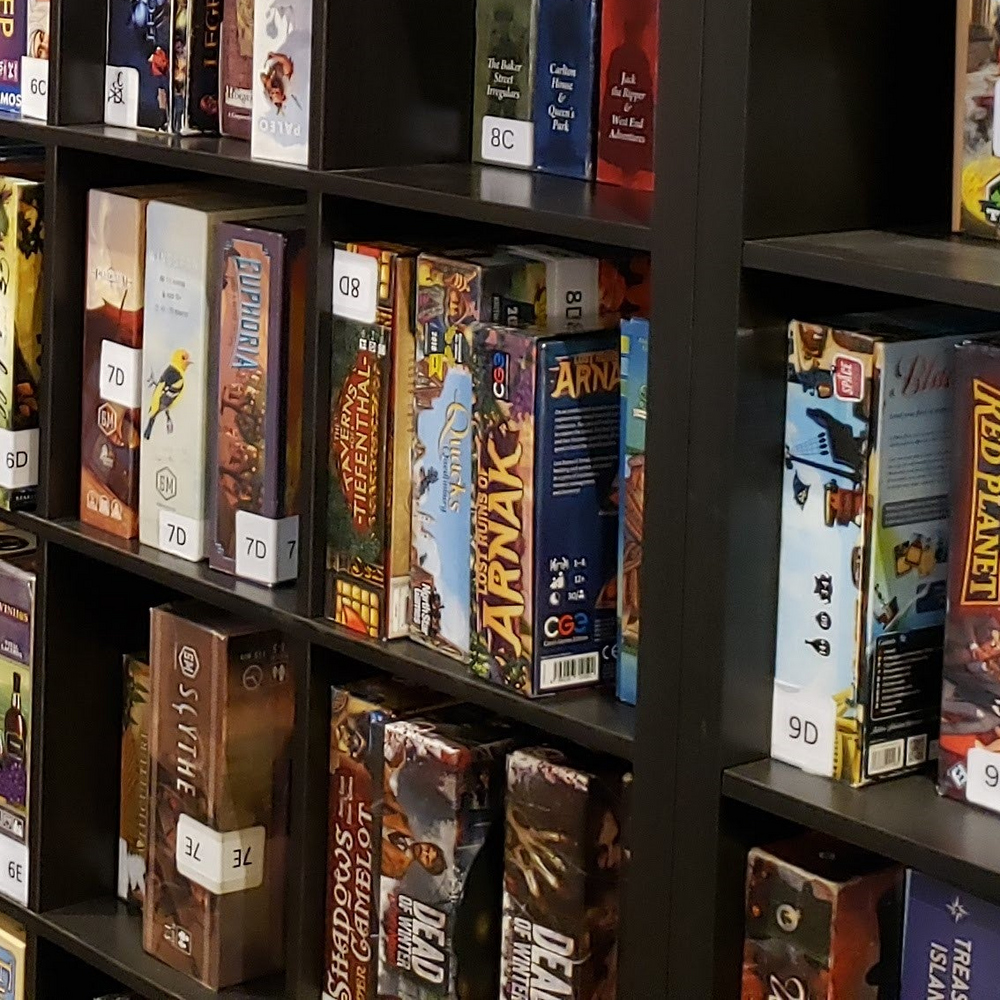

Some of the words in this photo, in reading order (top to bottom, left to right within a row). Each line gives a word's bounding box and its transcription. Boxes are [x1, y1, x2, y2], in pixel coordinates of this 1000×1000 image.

[500, 58, 522, 72] Baker
[550, 62, 577, 78] Carlton
[551, 78, 574, 91] House
[620, 71, 636, 86] Jack
[486, 84, 521, 101] Irregulars
[259, 117, 302, 137] PALEO
[552, 119, 570, 132] Park
[490, 128, 514, 149] 8C
[339, 276, 360, 297] 8D
[232, 256, 262, 370] EUPHORIA
[108, 364, 125, 386] 7D
[338, 382, 359, 494] TAVERNS
[353, 363, 372, 515] TIEFENTHAL
[7, 450, 28, 468] 6D
[167, 524, 187, 546] 7D
[969, 470, 1000, 600] PLANET
[245, 537, 266, 559] 7D
[482, 441, 524, 658] ARNAK
[476, 552, 488, 596] LOST
[171, 683, 199, 798] SCYTHE
[788, 715, 819, 745] 9D
[185, 836, 202, 862] 7E
[233, 846, 253, 868] 7E
[8, 861, 22, 883] 6E
[350, 802, 373, 963] CAMELOT
[326, 822, 354, 1000] SHADOWS
[397, 911, 412, 971] WINTER
[411, 900, 446, 985] DEAD
